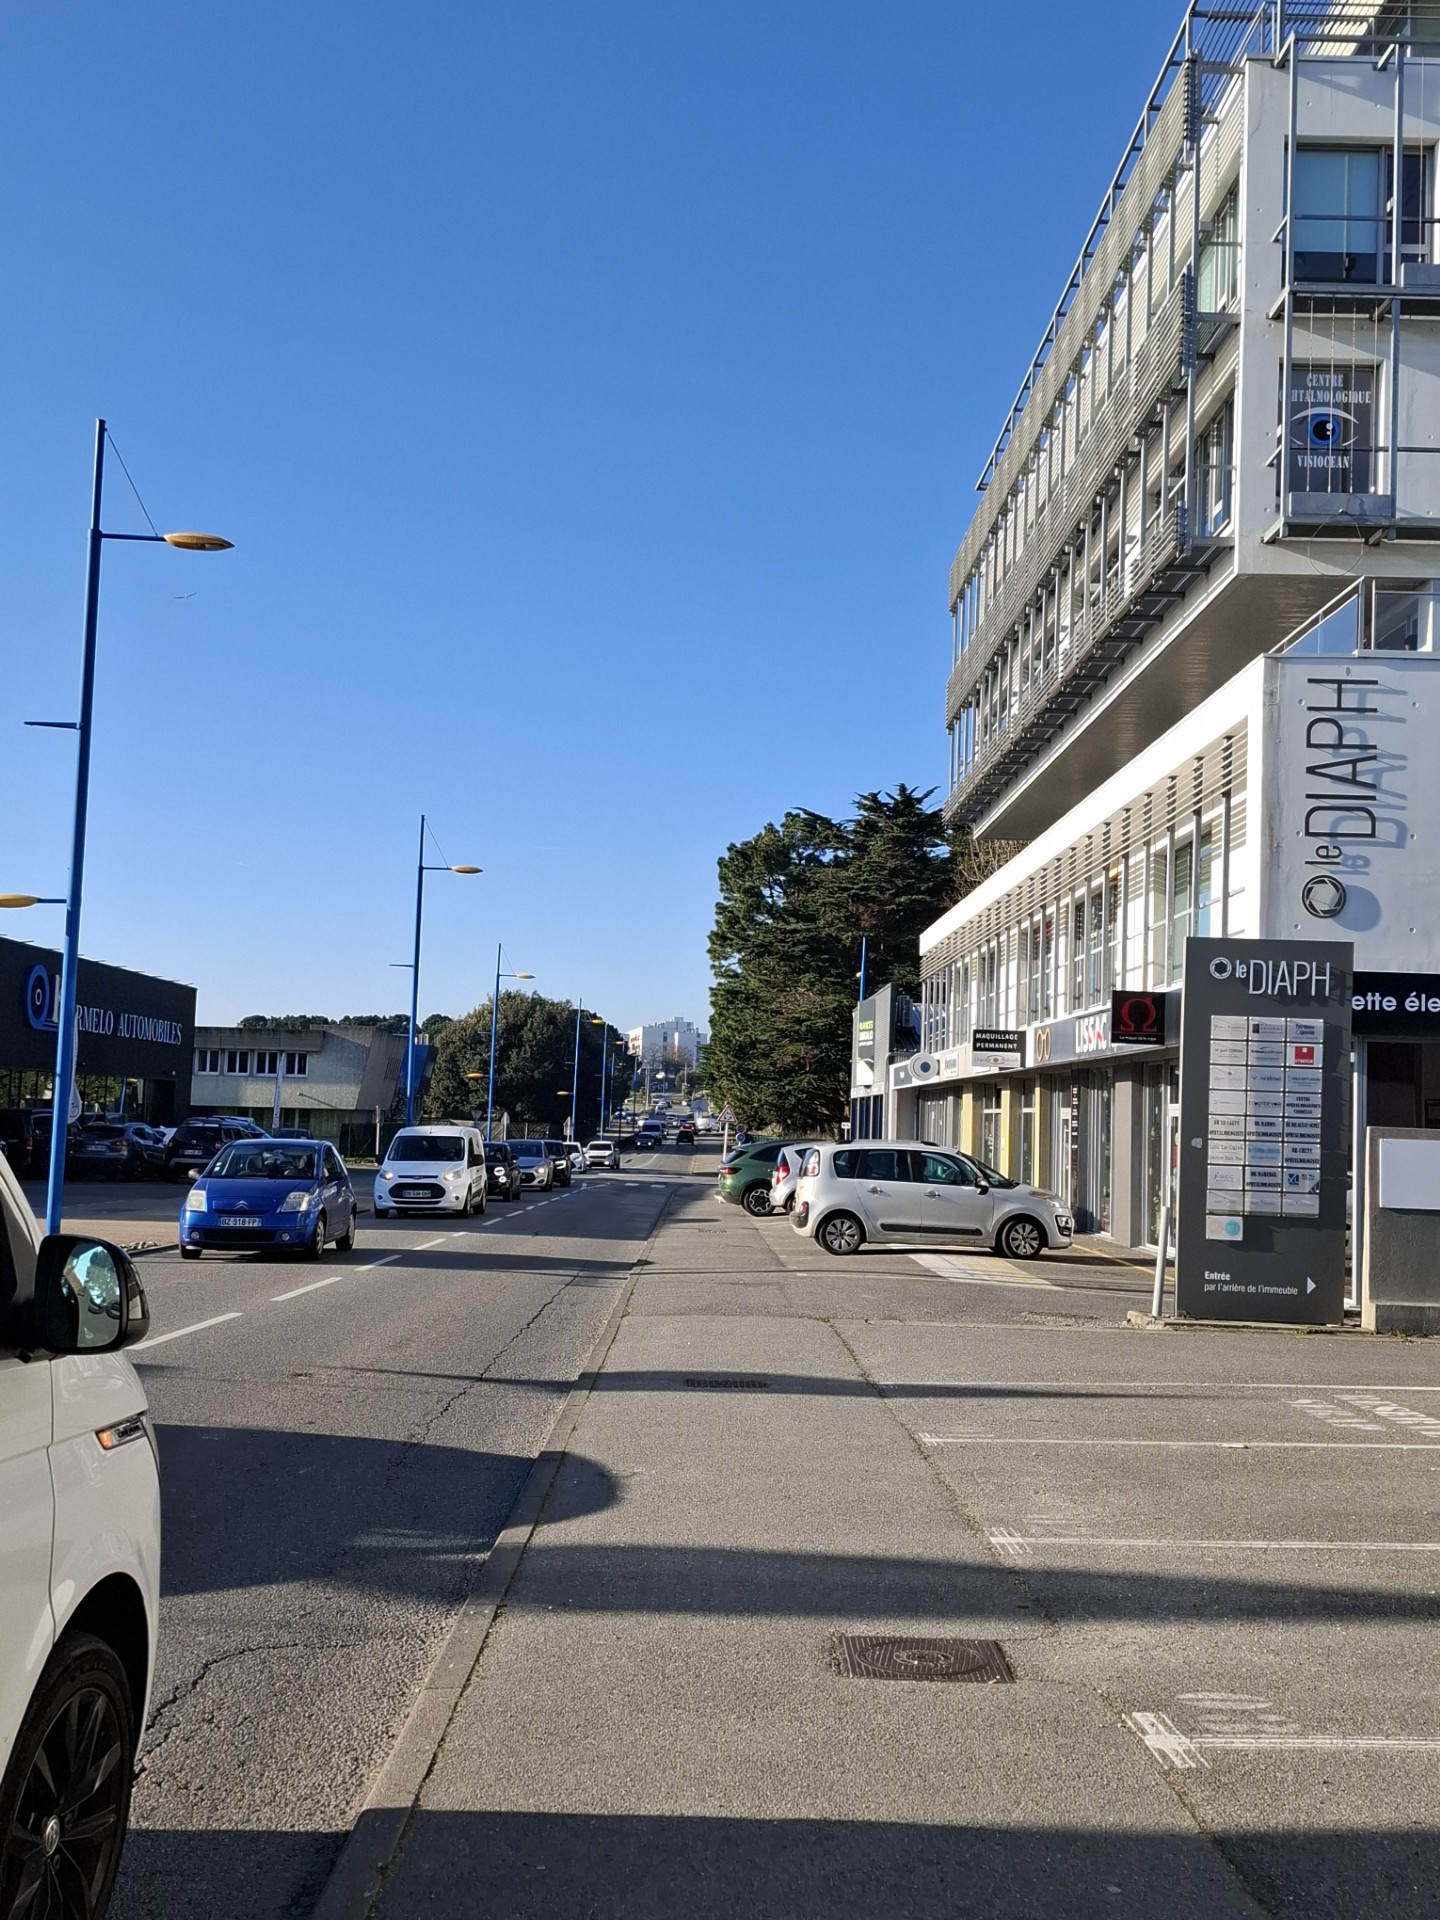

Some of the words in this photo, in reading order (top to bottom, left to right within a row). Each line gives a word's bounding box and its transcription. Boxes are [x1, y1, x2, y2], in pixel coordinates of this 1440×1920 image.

[1306, 374, 1344, 387] CENTRE
[1279, 389, 1372, 404] HTALMOLOGIQUE
[1297, 455, 1350, 468] VISIOCEAN
[1305, 678, 1378, 838] DIAPH
[1305, 845, 1342, 866] le
[1235, 959, 1247, 978] le
[1249, 960, 1330, 996] DIAPH
[117, 1013, 182, 1045] AUTOMOBILES
[1075, 1013, 1107, 1054] LISSAC
[1204, 1271, 1231, 1280] Entrée
[1204, 1283, 1216, 1292] par
[1218, 1283, 1245, 1292] l'arrière
[1247, 1284, 1256, 1293] de
[1258, 1285, 1298, 1295] l'immeuble
